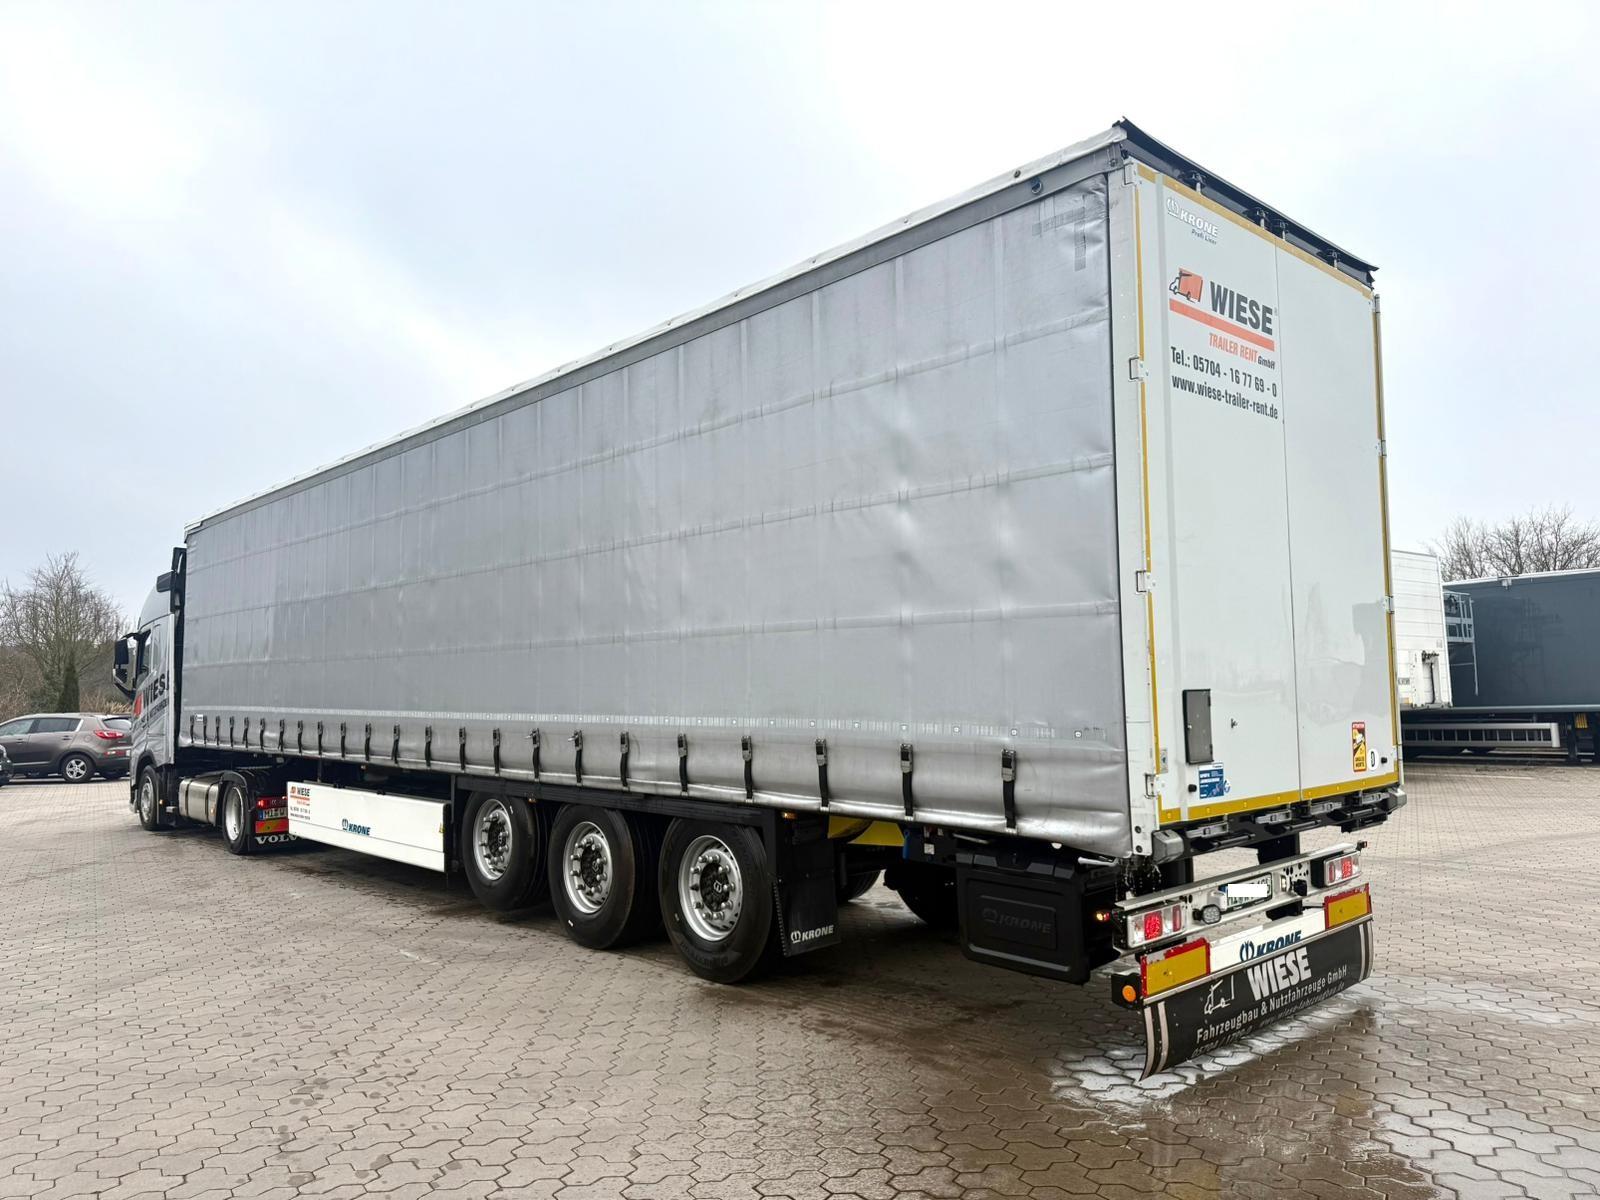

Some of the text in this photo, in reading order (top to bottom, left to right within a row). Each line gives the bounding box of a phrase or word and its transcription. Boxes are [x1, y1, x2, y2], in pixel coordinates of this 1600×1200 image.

[1180, 209, 1218, 237] KRONE
[1210, 281, 1273, 336] WIESE
[1209, 332, 1275, 370] TRAILER RENT GmbH
[1171, 346, 1191, 368] Tel.:
[1193, 354, 1221, 378] 05704
[1230, 367, 1241, 385] 16
[1242, 372, 1252, 390] 77
[1254, 375, 1265, 393] 69
[1272, 383, 1277, 398] 0
[1171, 374, 1279, 420] www.wiese-trailer-rent.de
[255, 833, 297, 845] VOLV
[348, 823, 371, 836] KRONE
[802, 924, 834, 942] KRONE
[999, 914, 1052, 934] KRONE
[1256, 930, 1302, 957] KRONE
[1246, 947, 1312, 1001] WIESE
[1196, 1006, 1259, 1044] Fahrzeugbau
[1261, 1001, 1268, 1015] &
[1269, 976, 1326, 1014] Nutzfahrzeuge
[1327, 964, 1348, 986] GmbH
